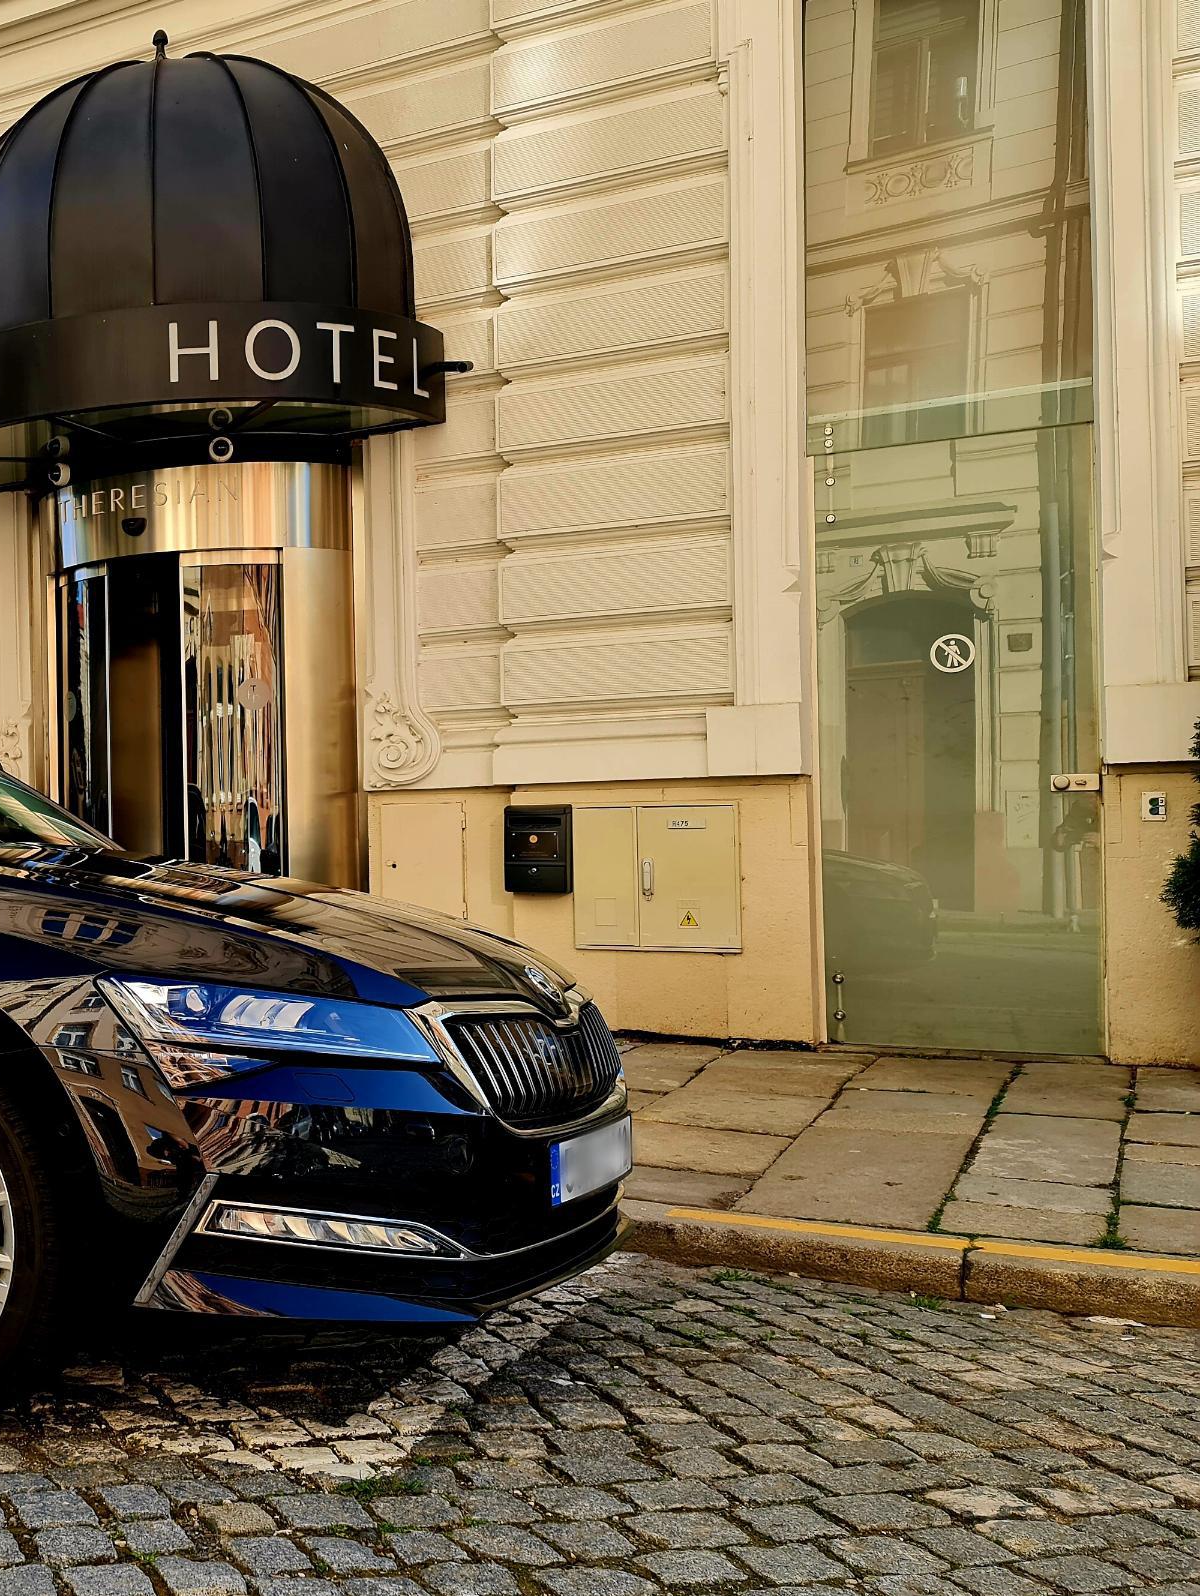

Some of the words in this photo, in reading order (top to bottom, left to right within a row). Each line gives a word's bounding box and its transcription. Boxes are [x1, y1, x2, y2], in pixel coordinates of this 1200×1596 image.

[169, 319, 430, 398] HOTEL
[58, 476, 240, 524] THERESIAN
[551, 1184, 560, 1198] CZ
